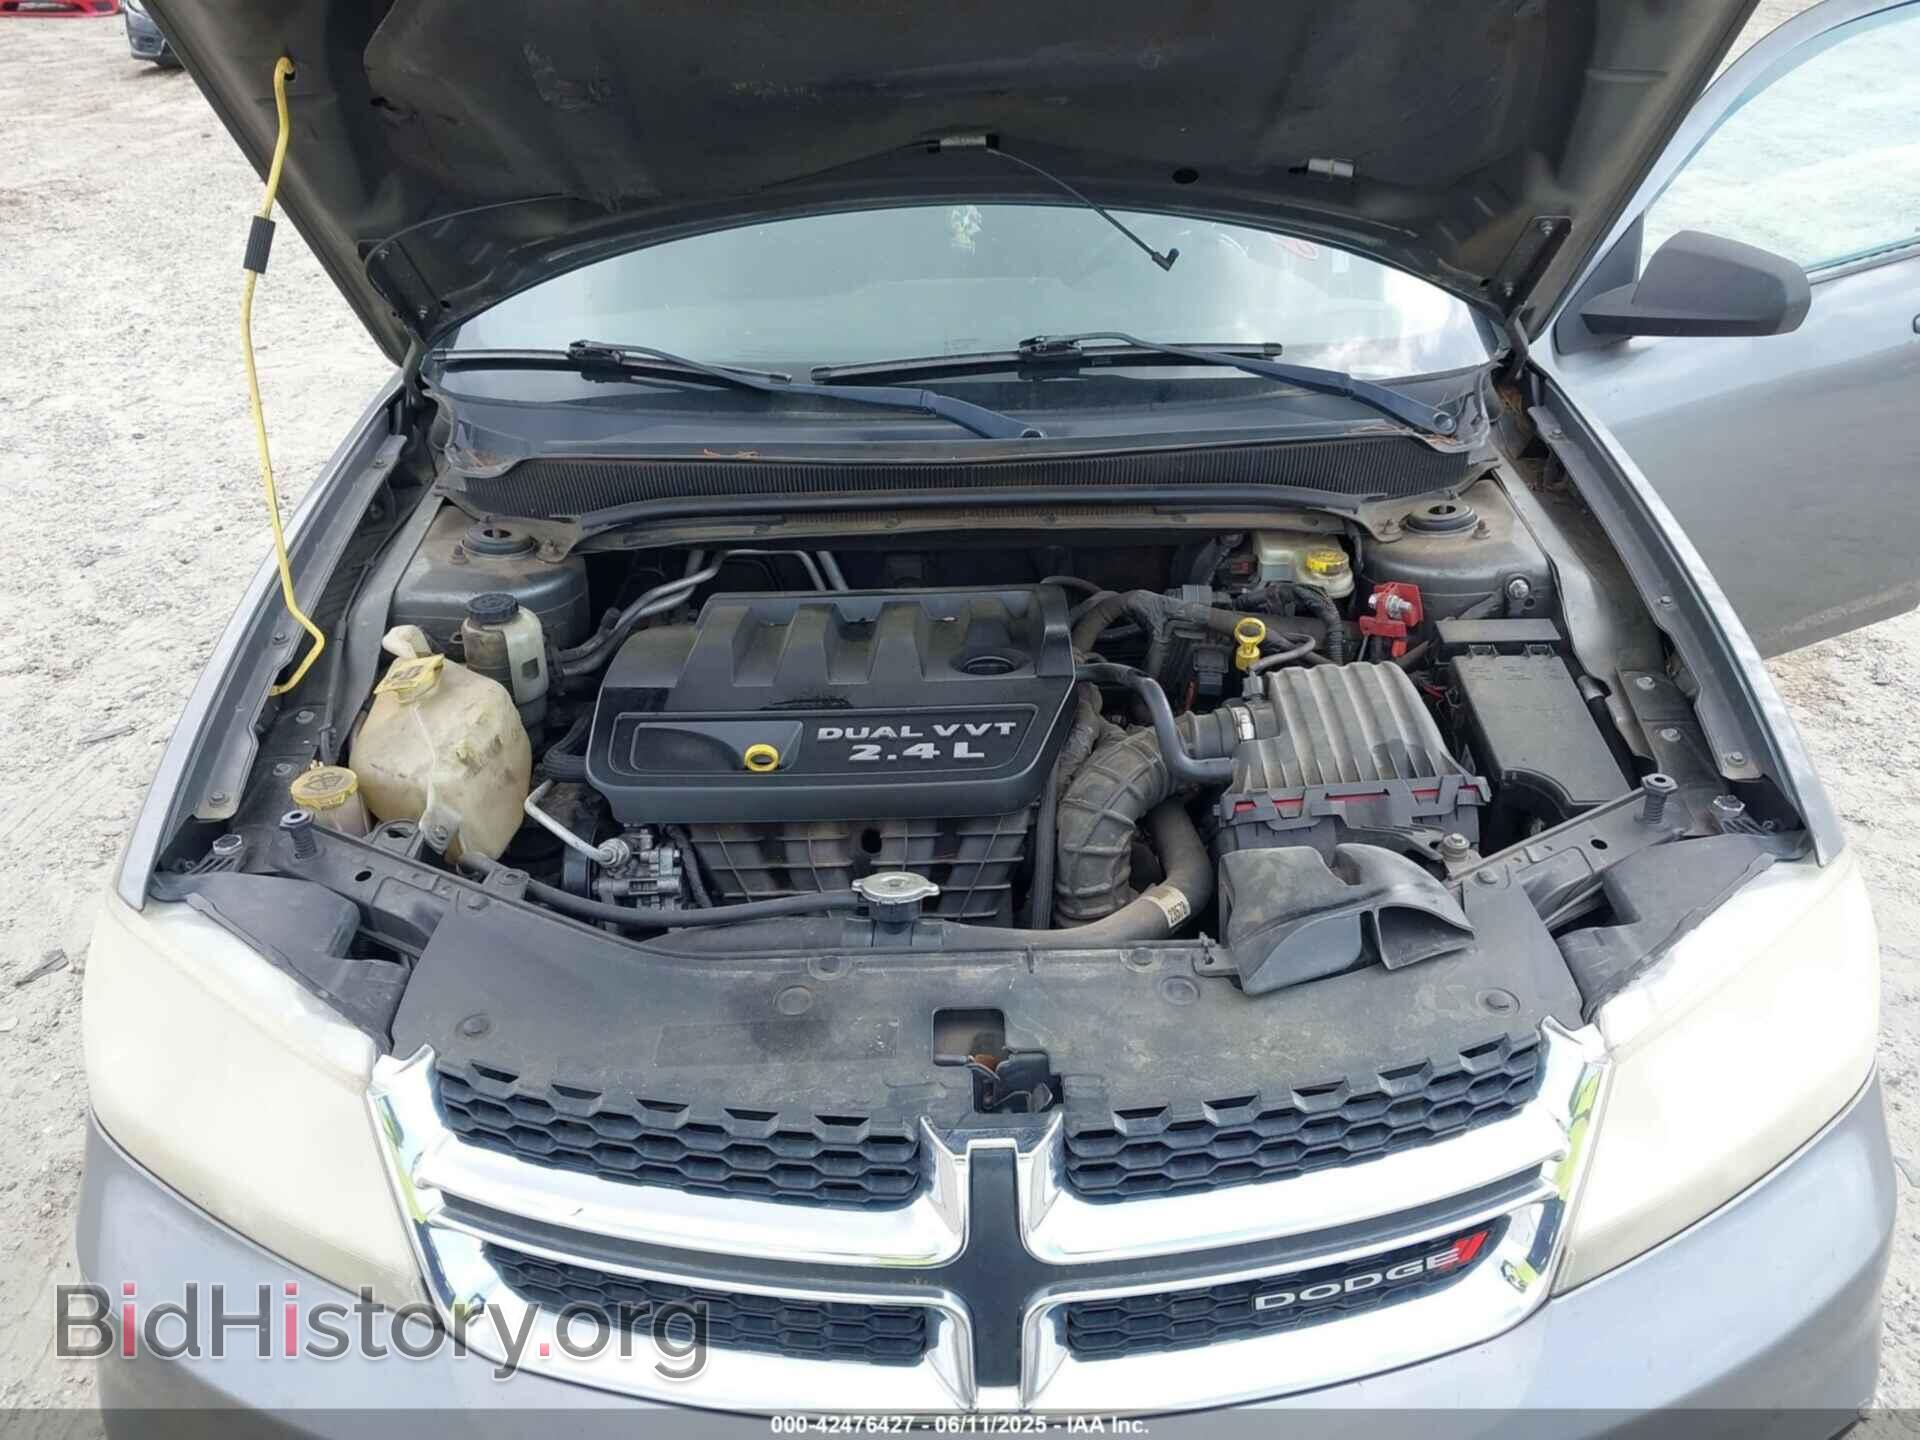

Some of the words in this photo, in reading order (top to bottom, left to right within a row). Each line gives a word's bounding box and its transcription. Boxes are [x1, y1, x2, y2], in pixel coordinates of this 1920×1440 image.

[817, 726, 923, 740] DUAL
[933, 722, 1017, 736] VVT
[1255, 1247, 1460, 1311] DODGE
